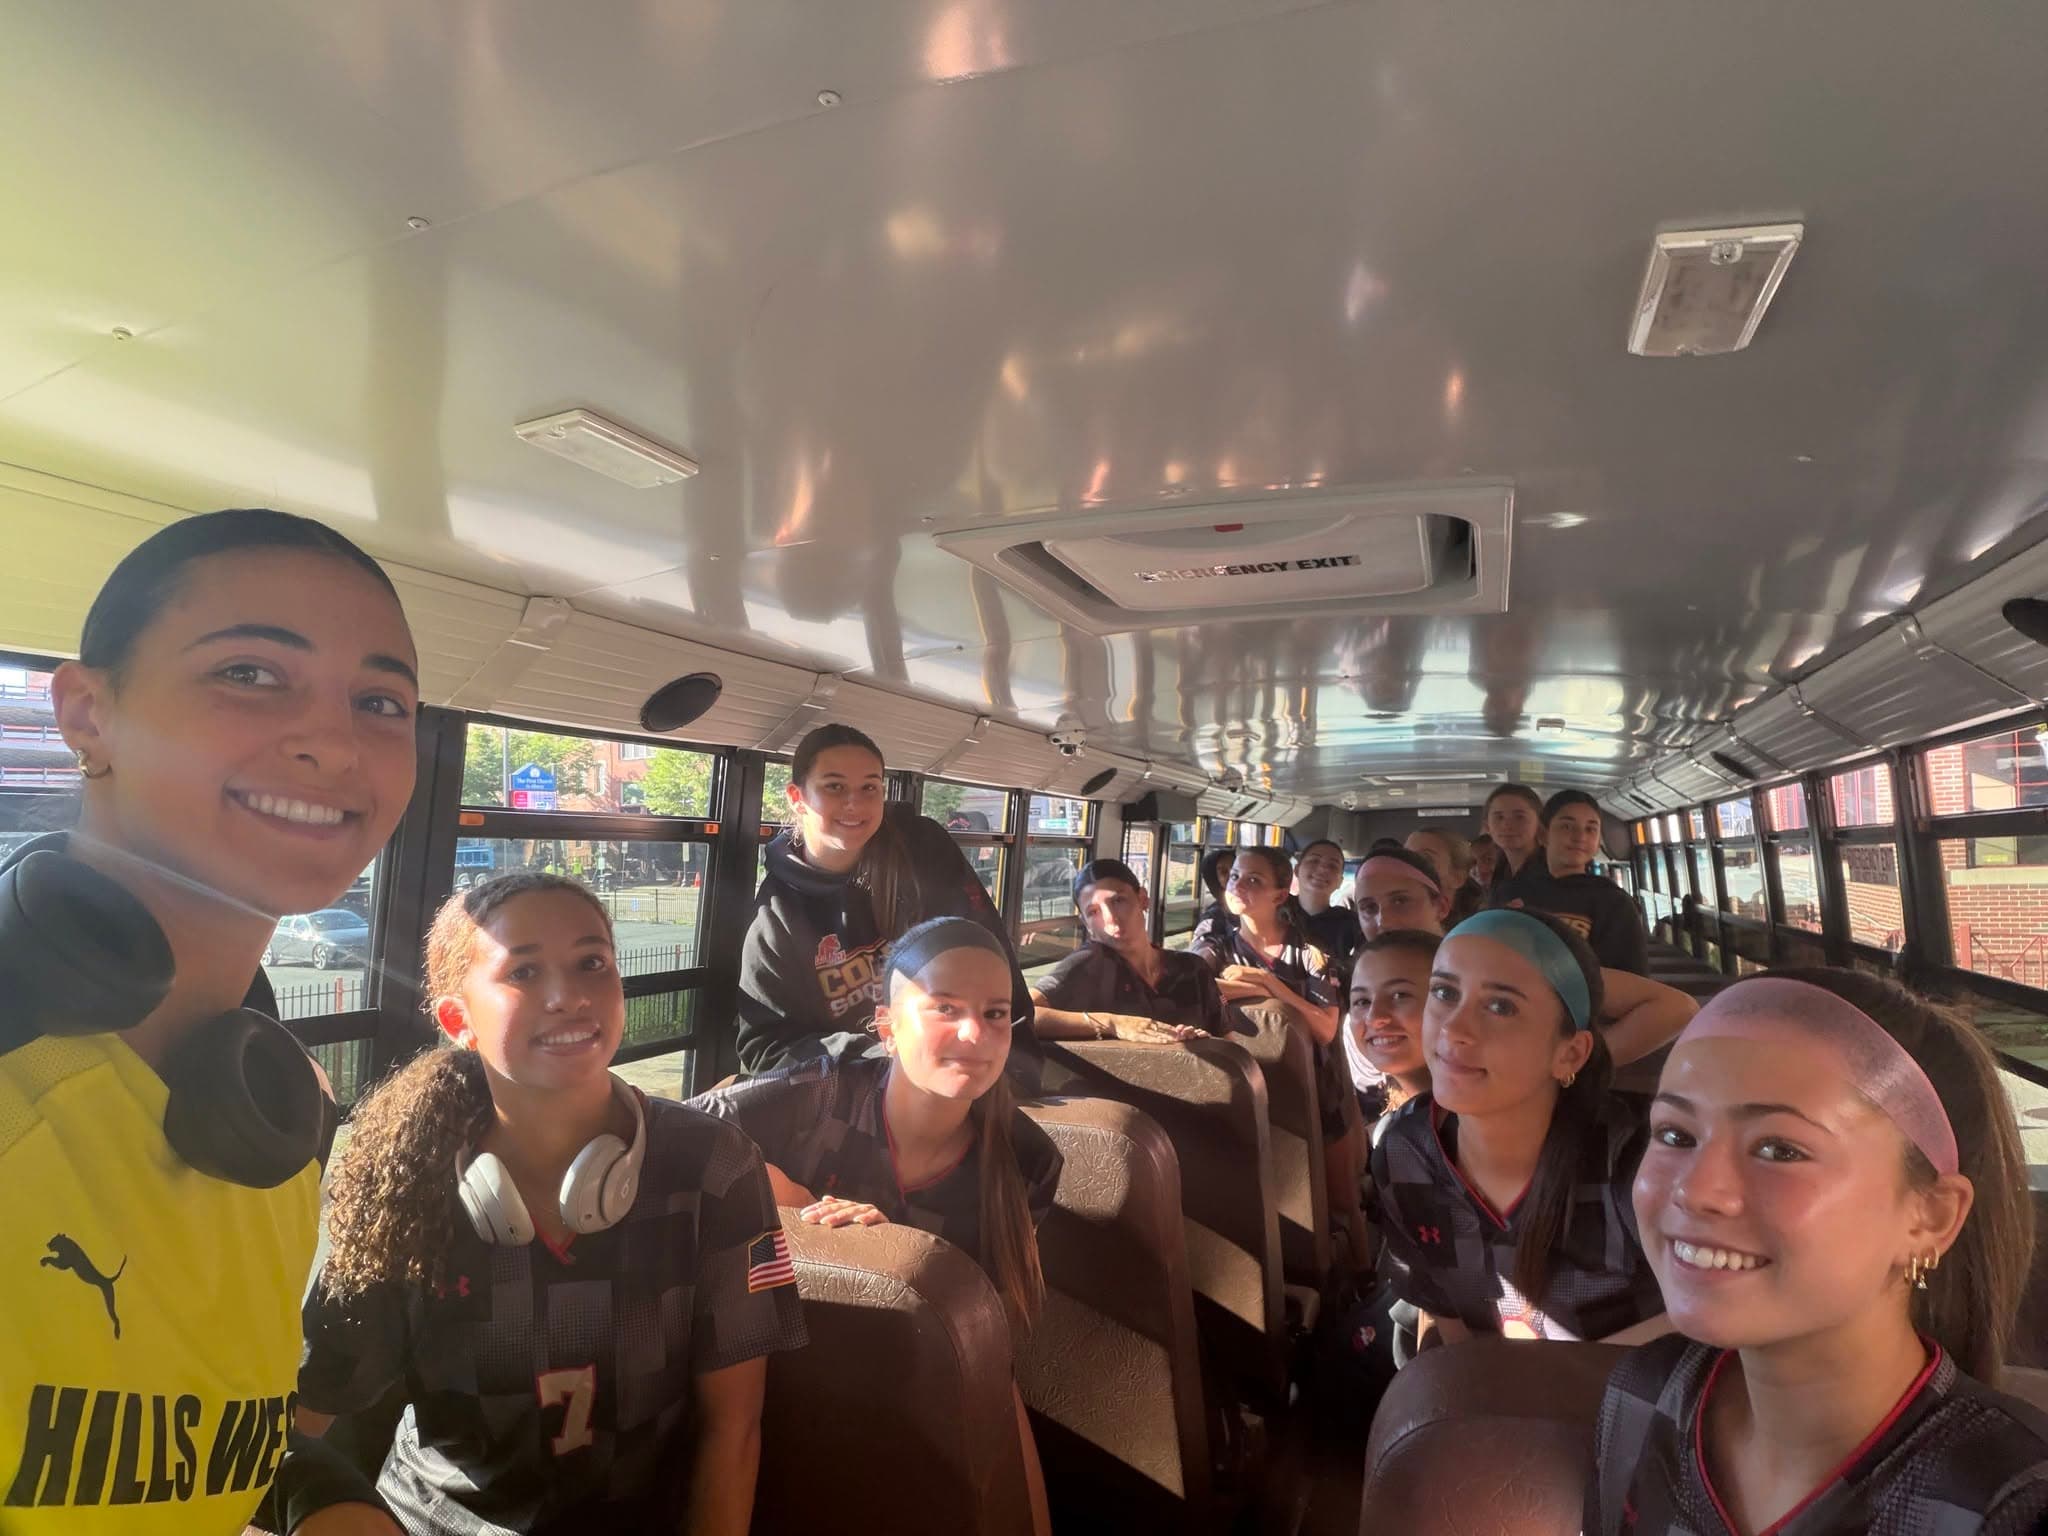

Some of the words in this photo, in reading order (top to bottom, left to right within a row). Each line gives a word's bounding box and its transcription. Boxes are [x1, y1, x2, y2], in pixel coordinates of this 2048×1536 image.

[1296, 555, 1354, 571] EXIT
[817, 943, 893, 999] COL
[830, 981, 885, 1017] SOCC
[535, 1362, 597, 1456] 7
[4, 1384, 201, 1507] HILLS
[206, 1391, 298, 1496] WE
